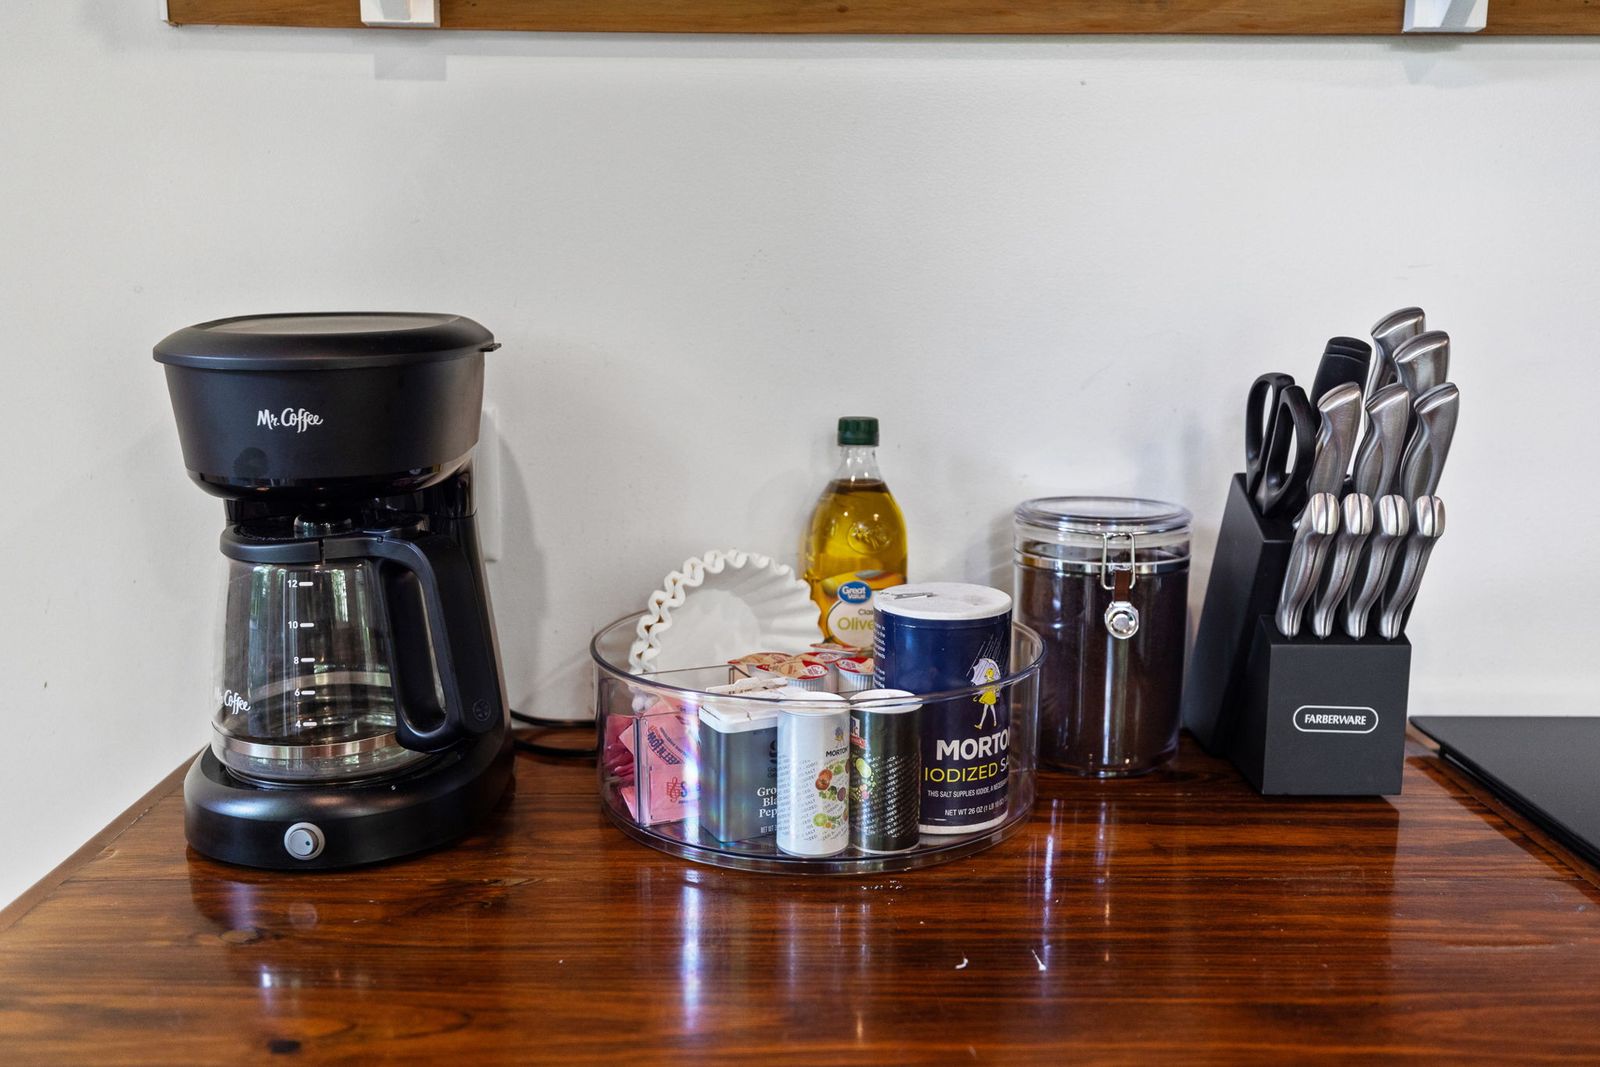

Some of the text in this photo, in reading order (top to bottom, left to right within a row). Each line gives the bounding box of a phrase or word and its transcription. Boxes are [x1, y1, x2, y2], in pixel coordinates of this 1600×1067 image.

[257, 407, 324, 433] Mr. Coffee
[287, 580, 298, 588] 12
[841, 586, 866, 595] Great
[288, 621, 298, 629] 10
[293, 656, 299, 664] 8
[294, 689, 300, 697] 6
[224, 689, 251, 715] Coffee
[295, 720, 301, 728] 4
[1304, 713, 1367, 726] FARBERWARE
[924, 762, 998, 783] IODIZED
[757, 787, 777, 797] Gro
[927, 789, 939, 798] THIS
[940, 790, 952, 798] SALT
[953, 789, 975, 798] SUPPLIES
[759, 808, 777, 818] Pep
[944, 808, 957, 817] NET
[957, 808, 967, 816] WT
[968, 807, 975, 815] 26
